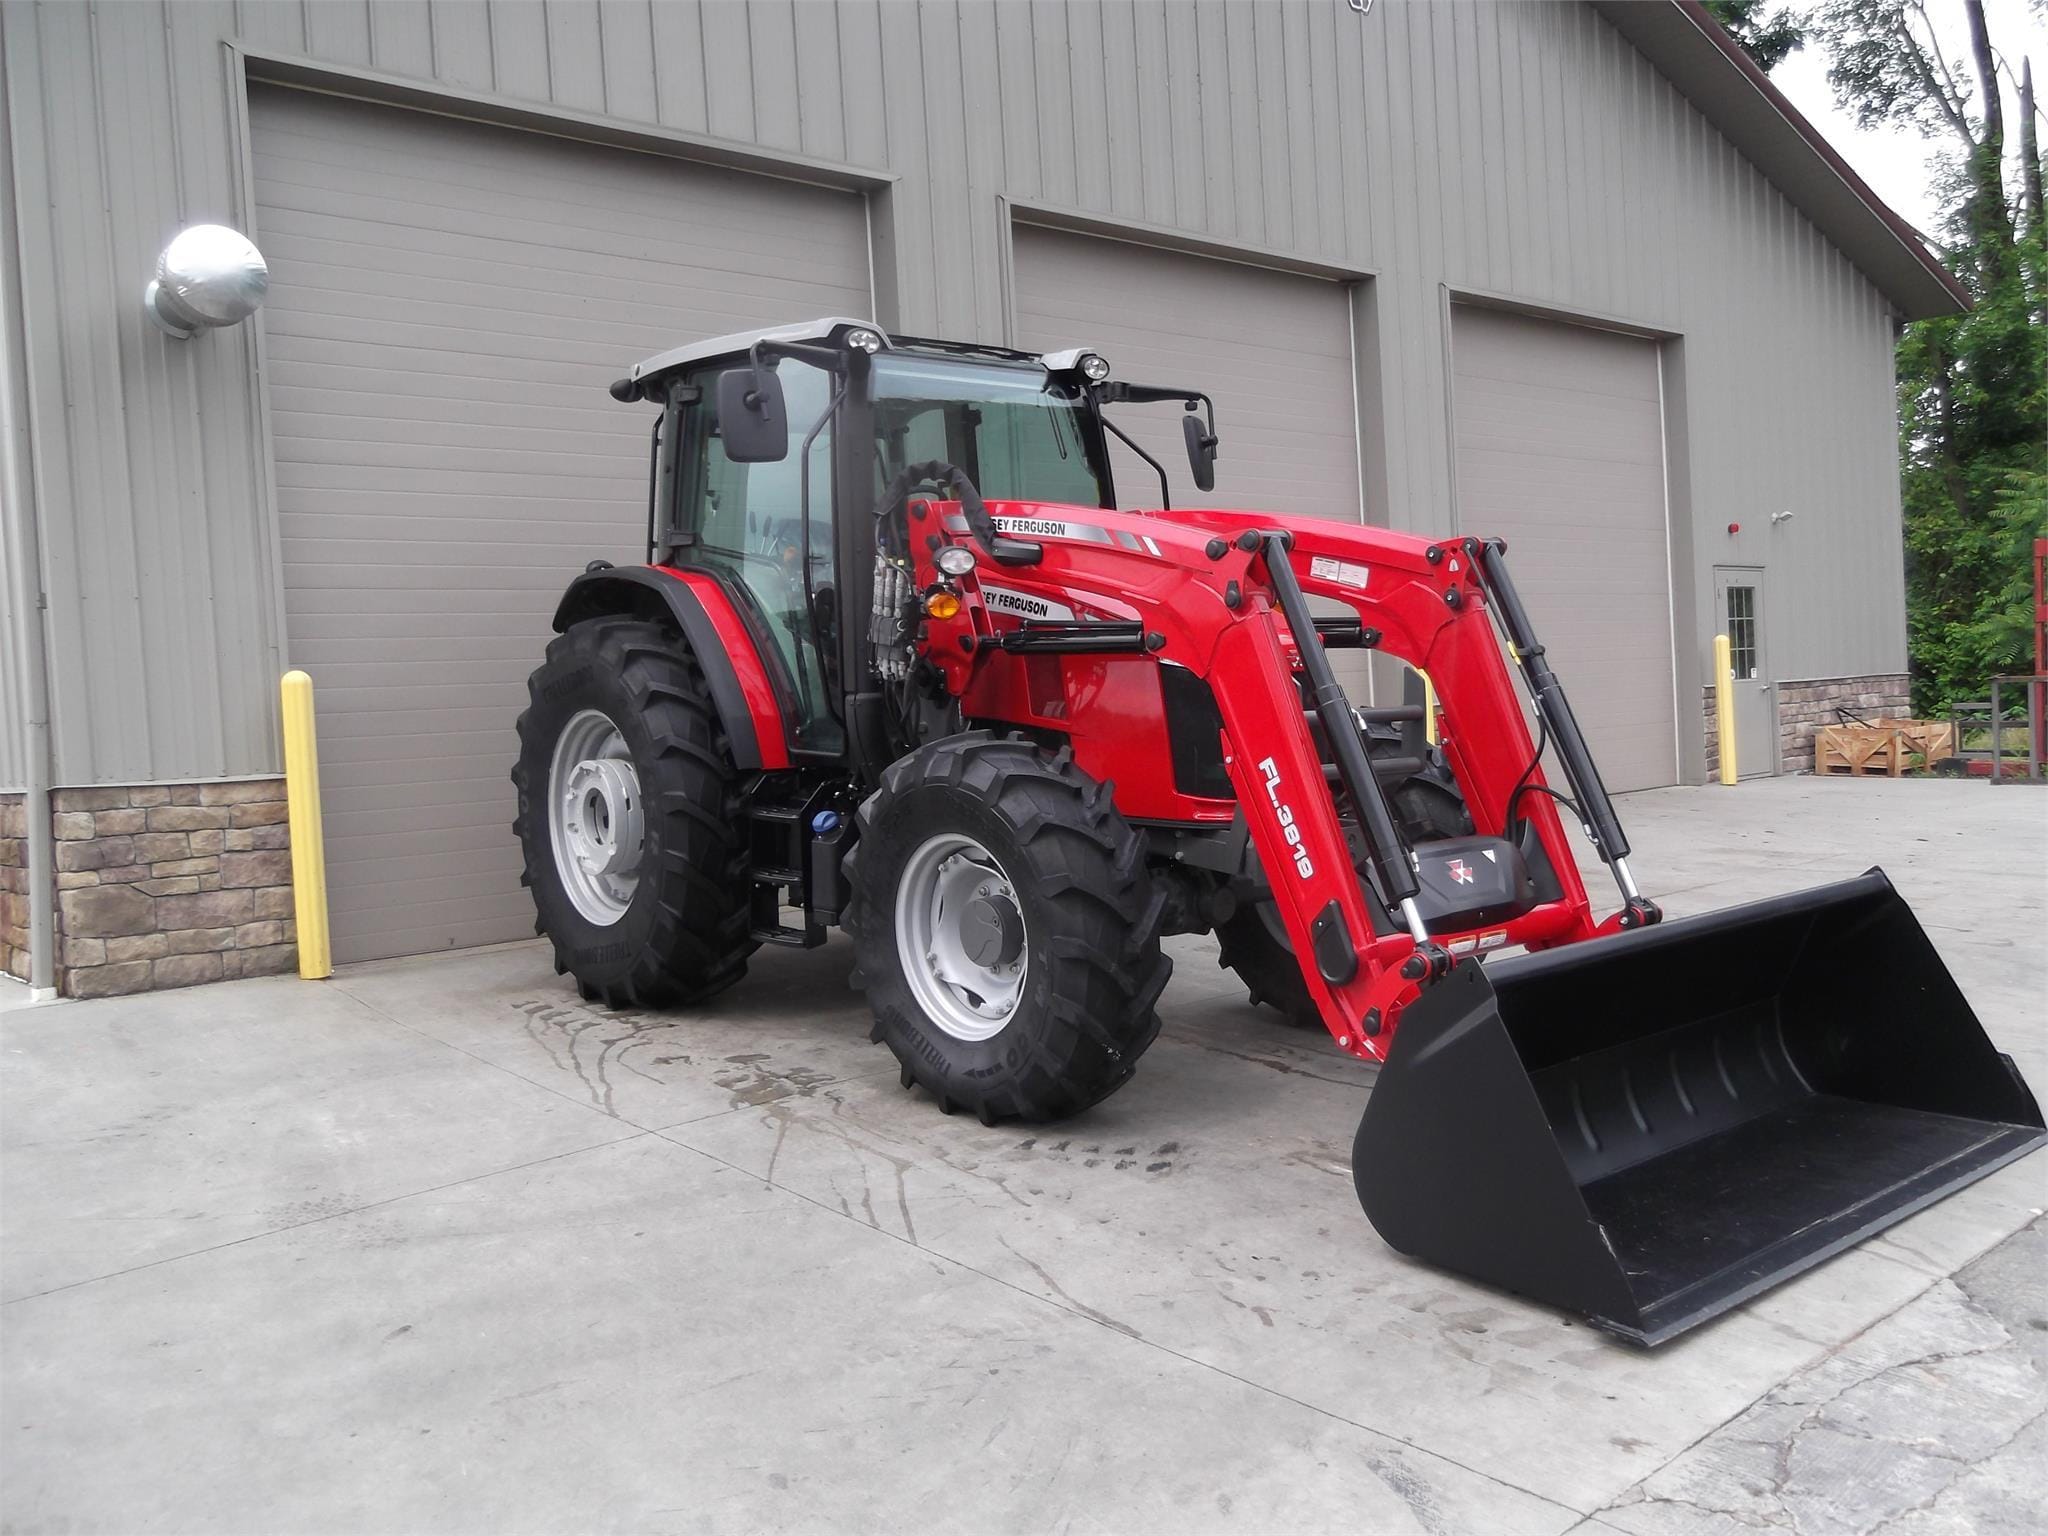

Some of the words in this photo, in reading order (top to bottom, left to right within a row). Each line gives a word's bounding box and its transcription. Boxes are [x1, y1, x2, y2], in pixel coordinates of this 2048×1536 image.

[1012, 519, 1066, 536] FERGUSON
[983, 591, 997, 604] EY
[998, 593, 1048, 617] FERGUSON
[1258, 756, 1314, 879] FL.3819
